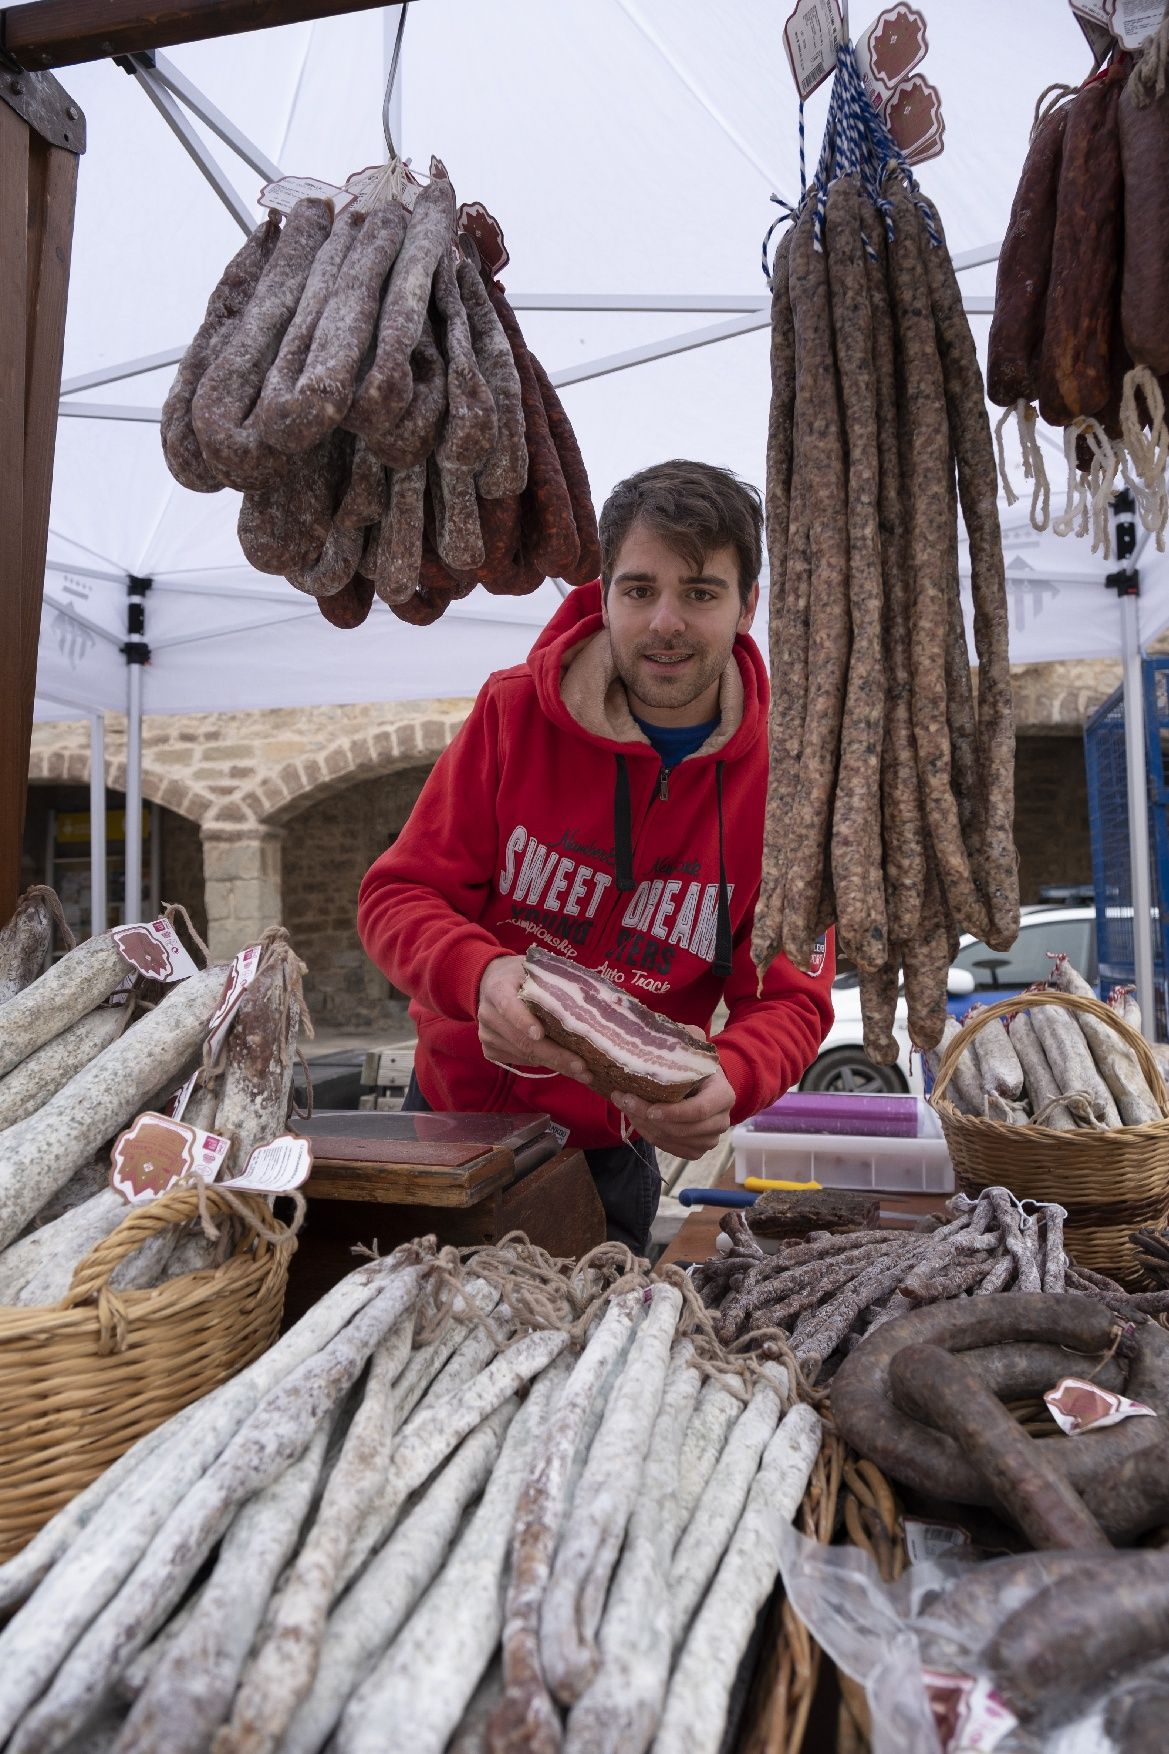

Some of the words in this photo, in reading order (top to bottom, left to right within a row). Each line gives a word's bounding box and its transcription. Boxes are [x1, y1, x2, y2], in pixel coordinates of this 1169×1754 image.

[499, 825, 612, 918] SWEET
[511, 903, 593, 945] YOUNG
[631, 969, 671, 994] Track
